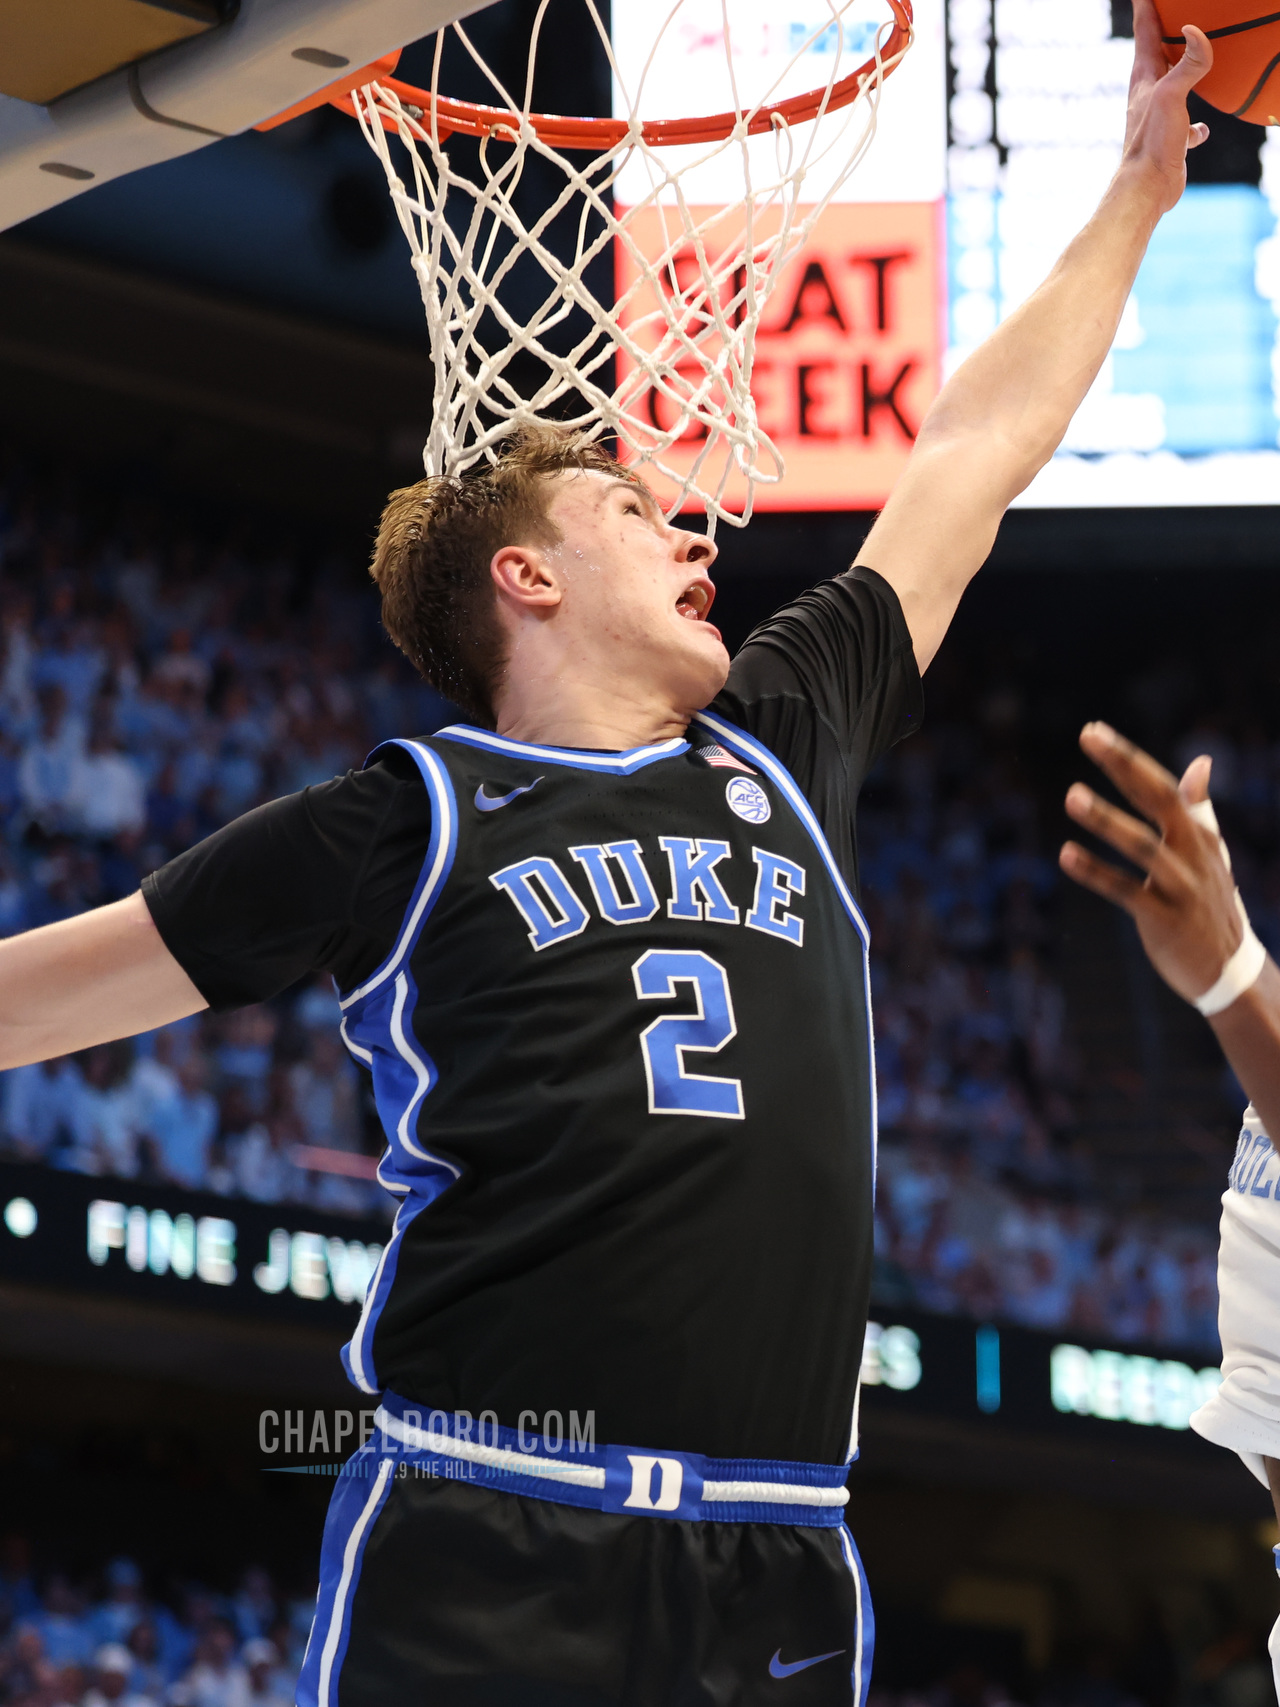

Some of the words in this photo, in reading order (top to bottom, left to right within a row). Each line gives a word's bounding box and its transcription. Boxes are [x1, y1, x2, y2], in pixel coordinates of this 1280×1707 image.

[734, 793, 764, 808] ACC
[489, 836, 806, 952] DUKE
[631, 949, 745, 1120] 2
[87, 1200, 237, 1286] FINE
